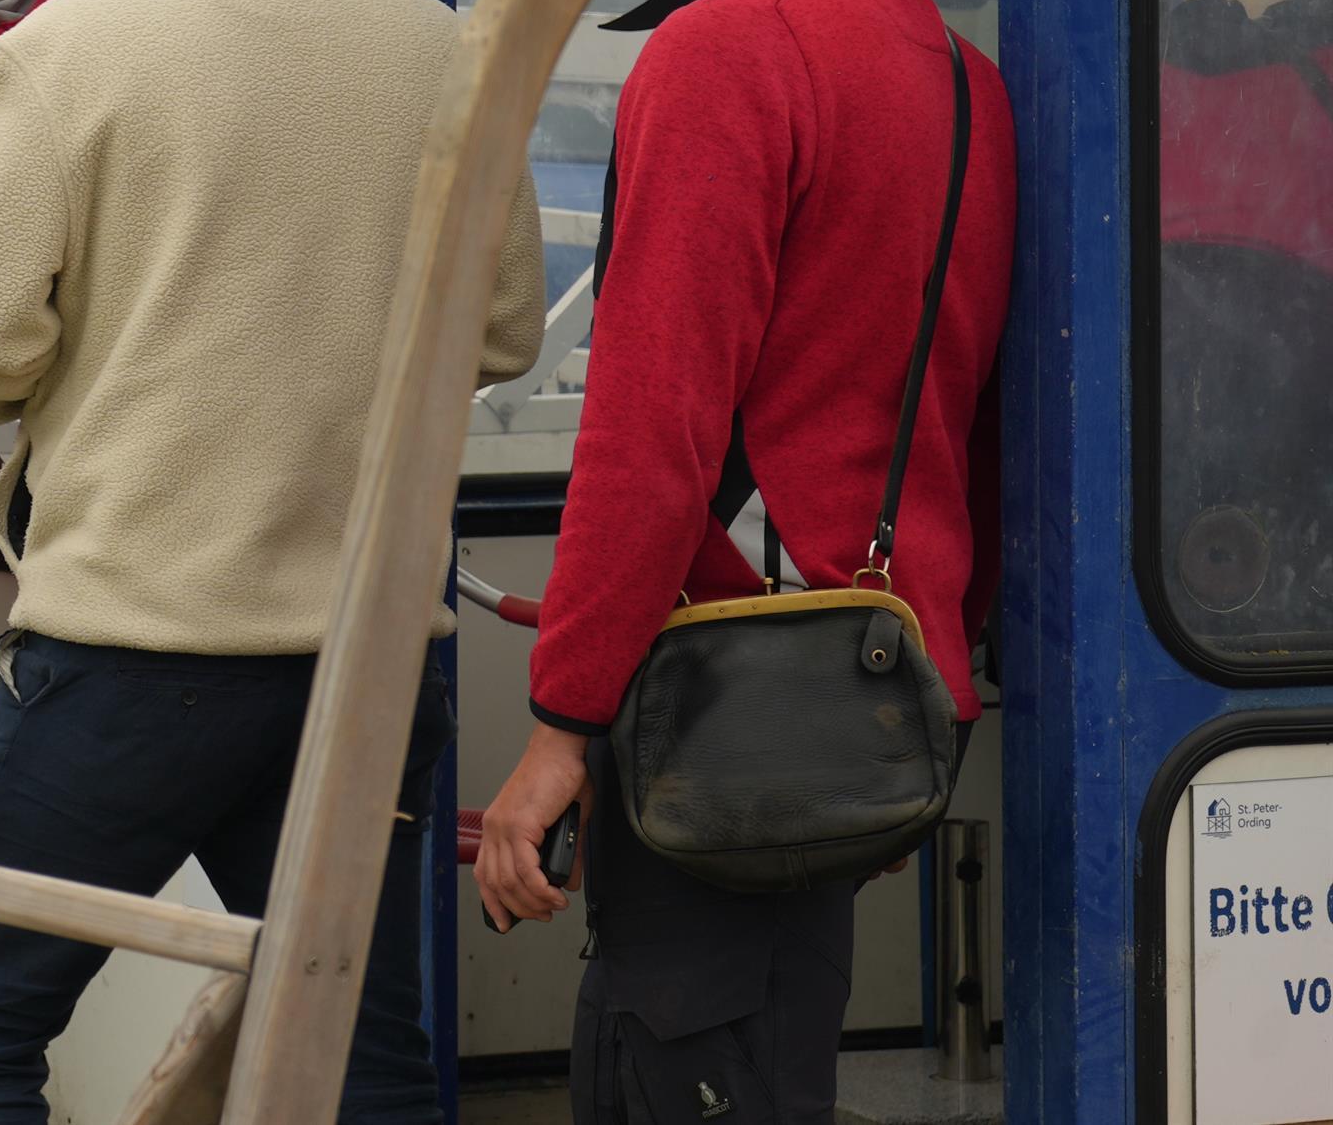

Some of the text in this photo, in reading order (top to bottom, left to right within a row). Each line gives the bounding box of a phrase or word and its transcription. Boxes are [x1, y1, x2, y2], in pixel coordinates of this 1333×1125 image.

[1238, 803, 1283, 815] St. Peter-
[1237, 817, 1271, 830] Ording
[1209, 883, 1313, 938] Bitte
